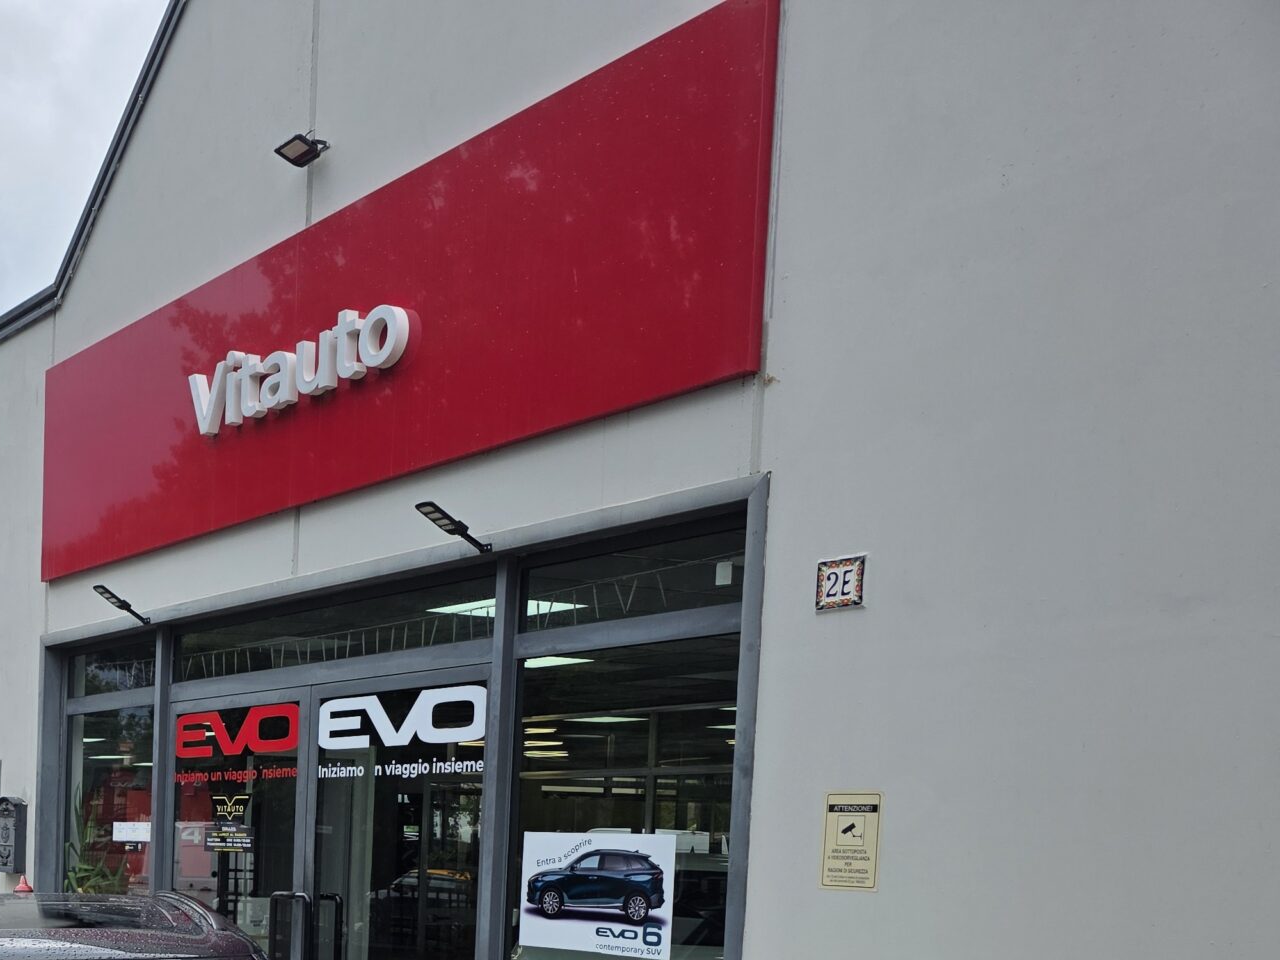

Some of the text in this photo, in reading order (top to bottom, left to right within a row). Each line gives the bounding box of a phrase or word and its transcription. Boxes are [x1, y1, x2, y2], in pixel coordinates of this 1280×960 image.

[188, 304, 410, 436] Vitauto
[826, 569, 854, 598] 2E
[176, 703, 300, 758] EVO
[318, 685, 487, 750] EVO
[210, 772, 222, 781] un
[224, 768, 257, 783] viaggio
[319, 761, 365, 779] Iniziamo
[385, 759, 430, 778] viaggio
[432, 756, 484, 774] insieme
[536, 857, 557, 867] Entra
[564, 838, 593, 860] scoprire
[595, 923, 663, 947] EVO 6
[595, 943, 662, 955] contemporary SUV
